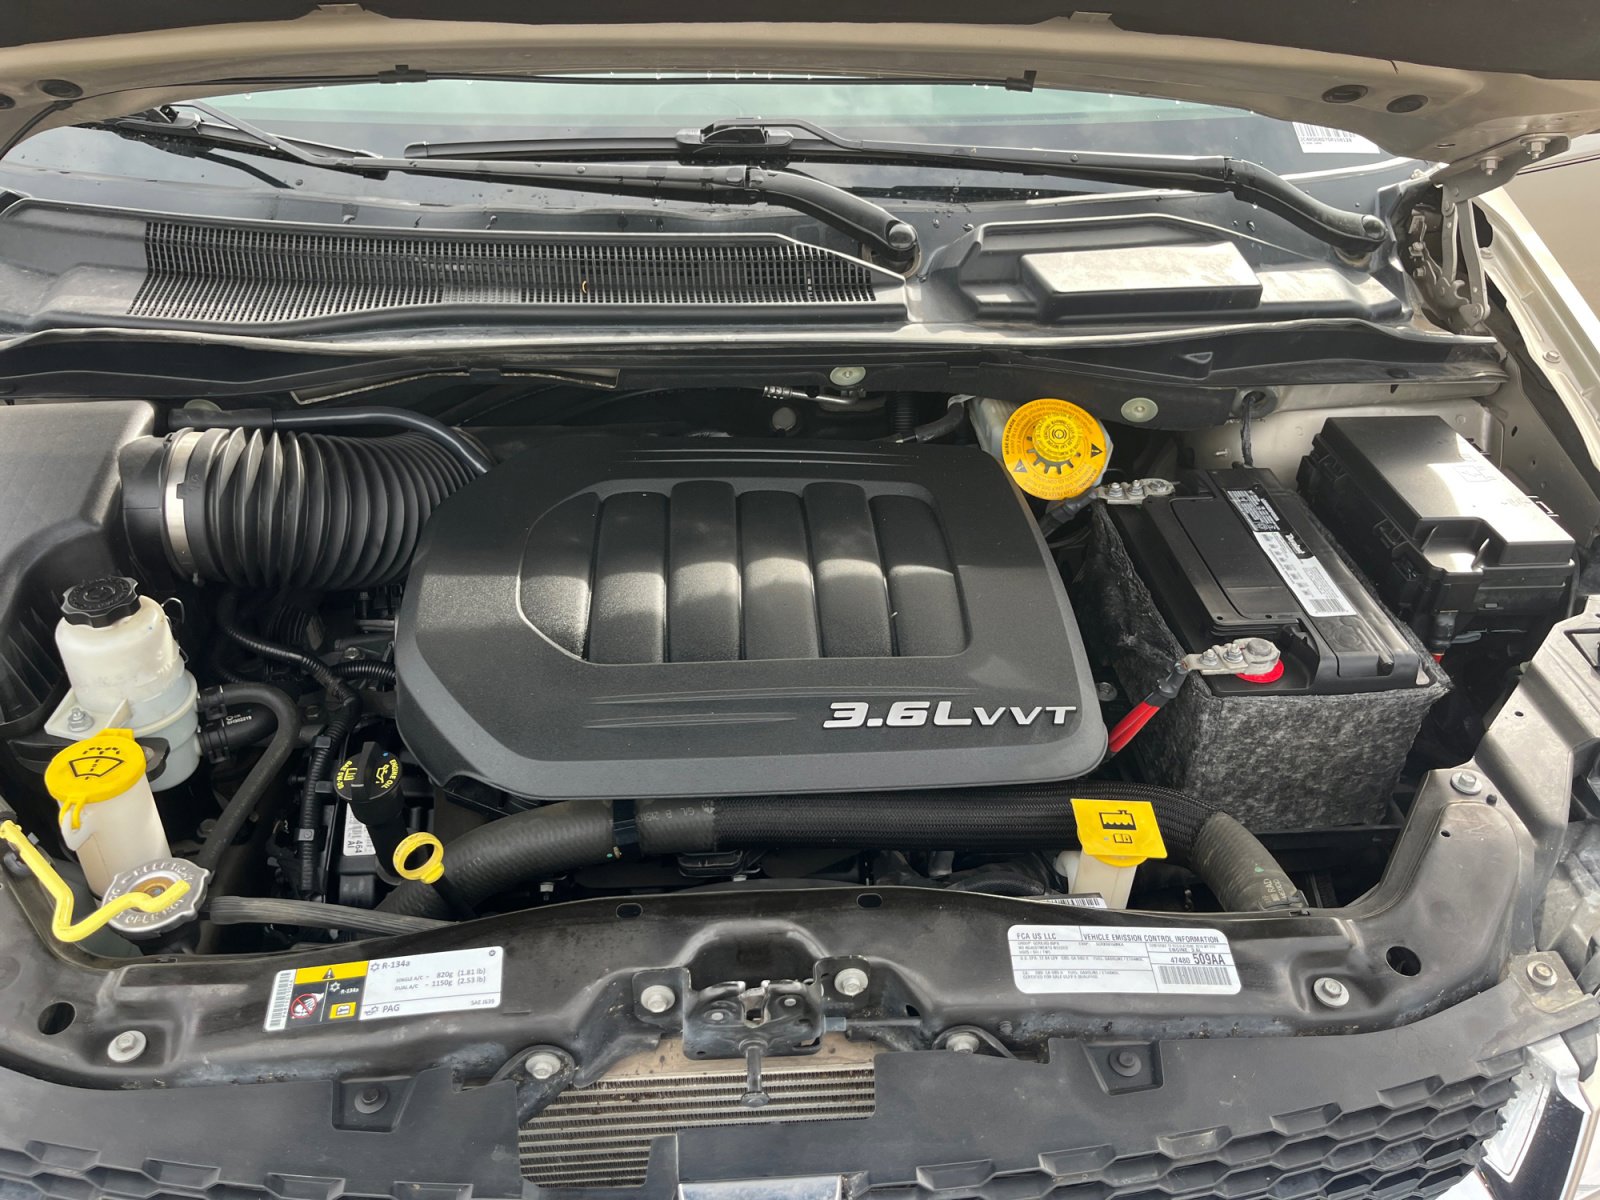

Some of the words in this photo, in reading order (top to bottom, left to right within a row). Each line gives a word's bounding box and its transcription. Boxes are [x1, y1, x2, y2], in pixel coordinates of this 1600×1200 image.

[823, 701, 972, 728] 3.6L
[973, 706, 1077, 725] VVT
[389, 759, 399, 780] ENGINE
[381, 780, 393, 789] OIL
[1016, 932, 1030, 940] FCA
[1032, 932, 1042, 940] US
[1083, 933, 1110, 941] VEHICLE
[1111, 934, 1142, 942] EMISSION
[1144, 935, 1174, 943] CONTROL
[1175, 935, 1220, 943] INFORMATION
[1192, 953, 1226, 965] 509AA
[381, 960, 411, 970] R-134a
[436, 970, 453, 979] 820g
[457, 969, 475, 977] (1.81
[476, 968, 486, 976] lb)
[432, 979, 453, 988] 1150g
[457, 977, 475, 986] (2.53
[476, 976, 486, 985] lb)
[382, 1004, 400, 1013] PAG
